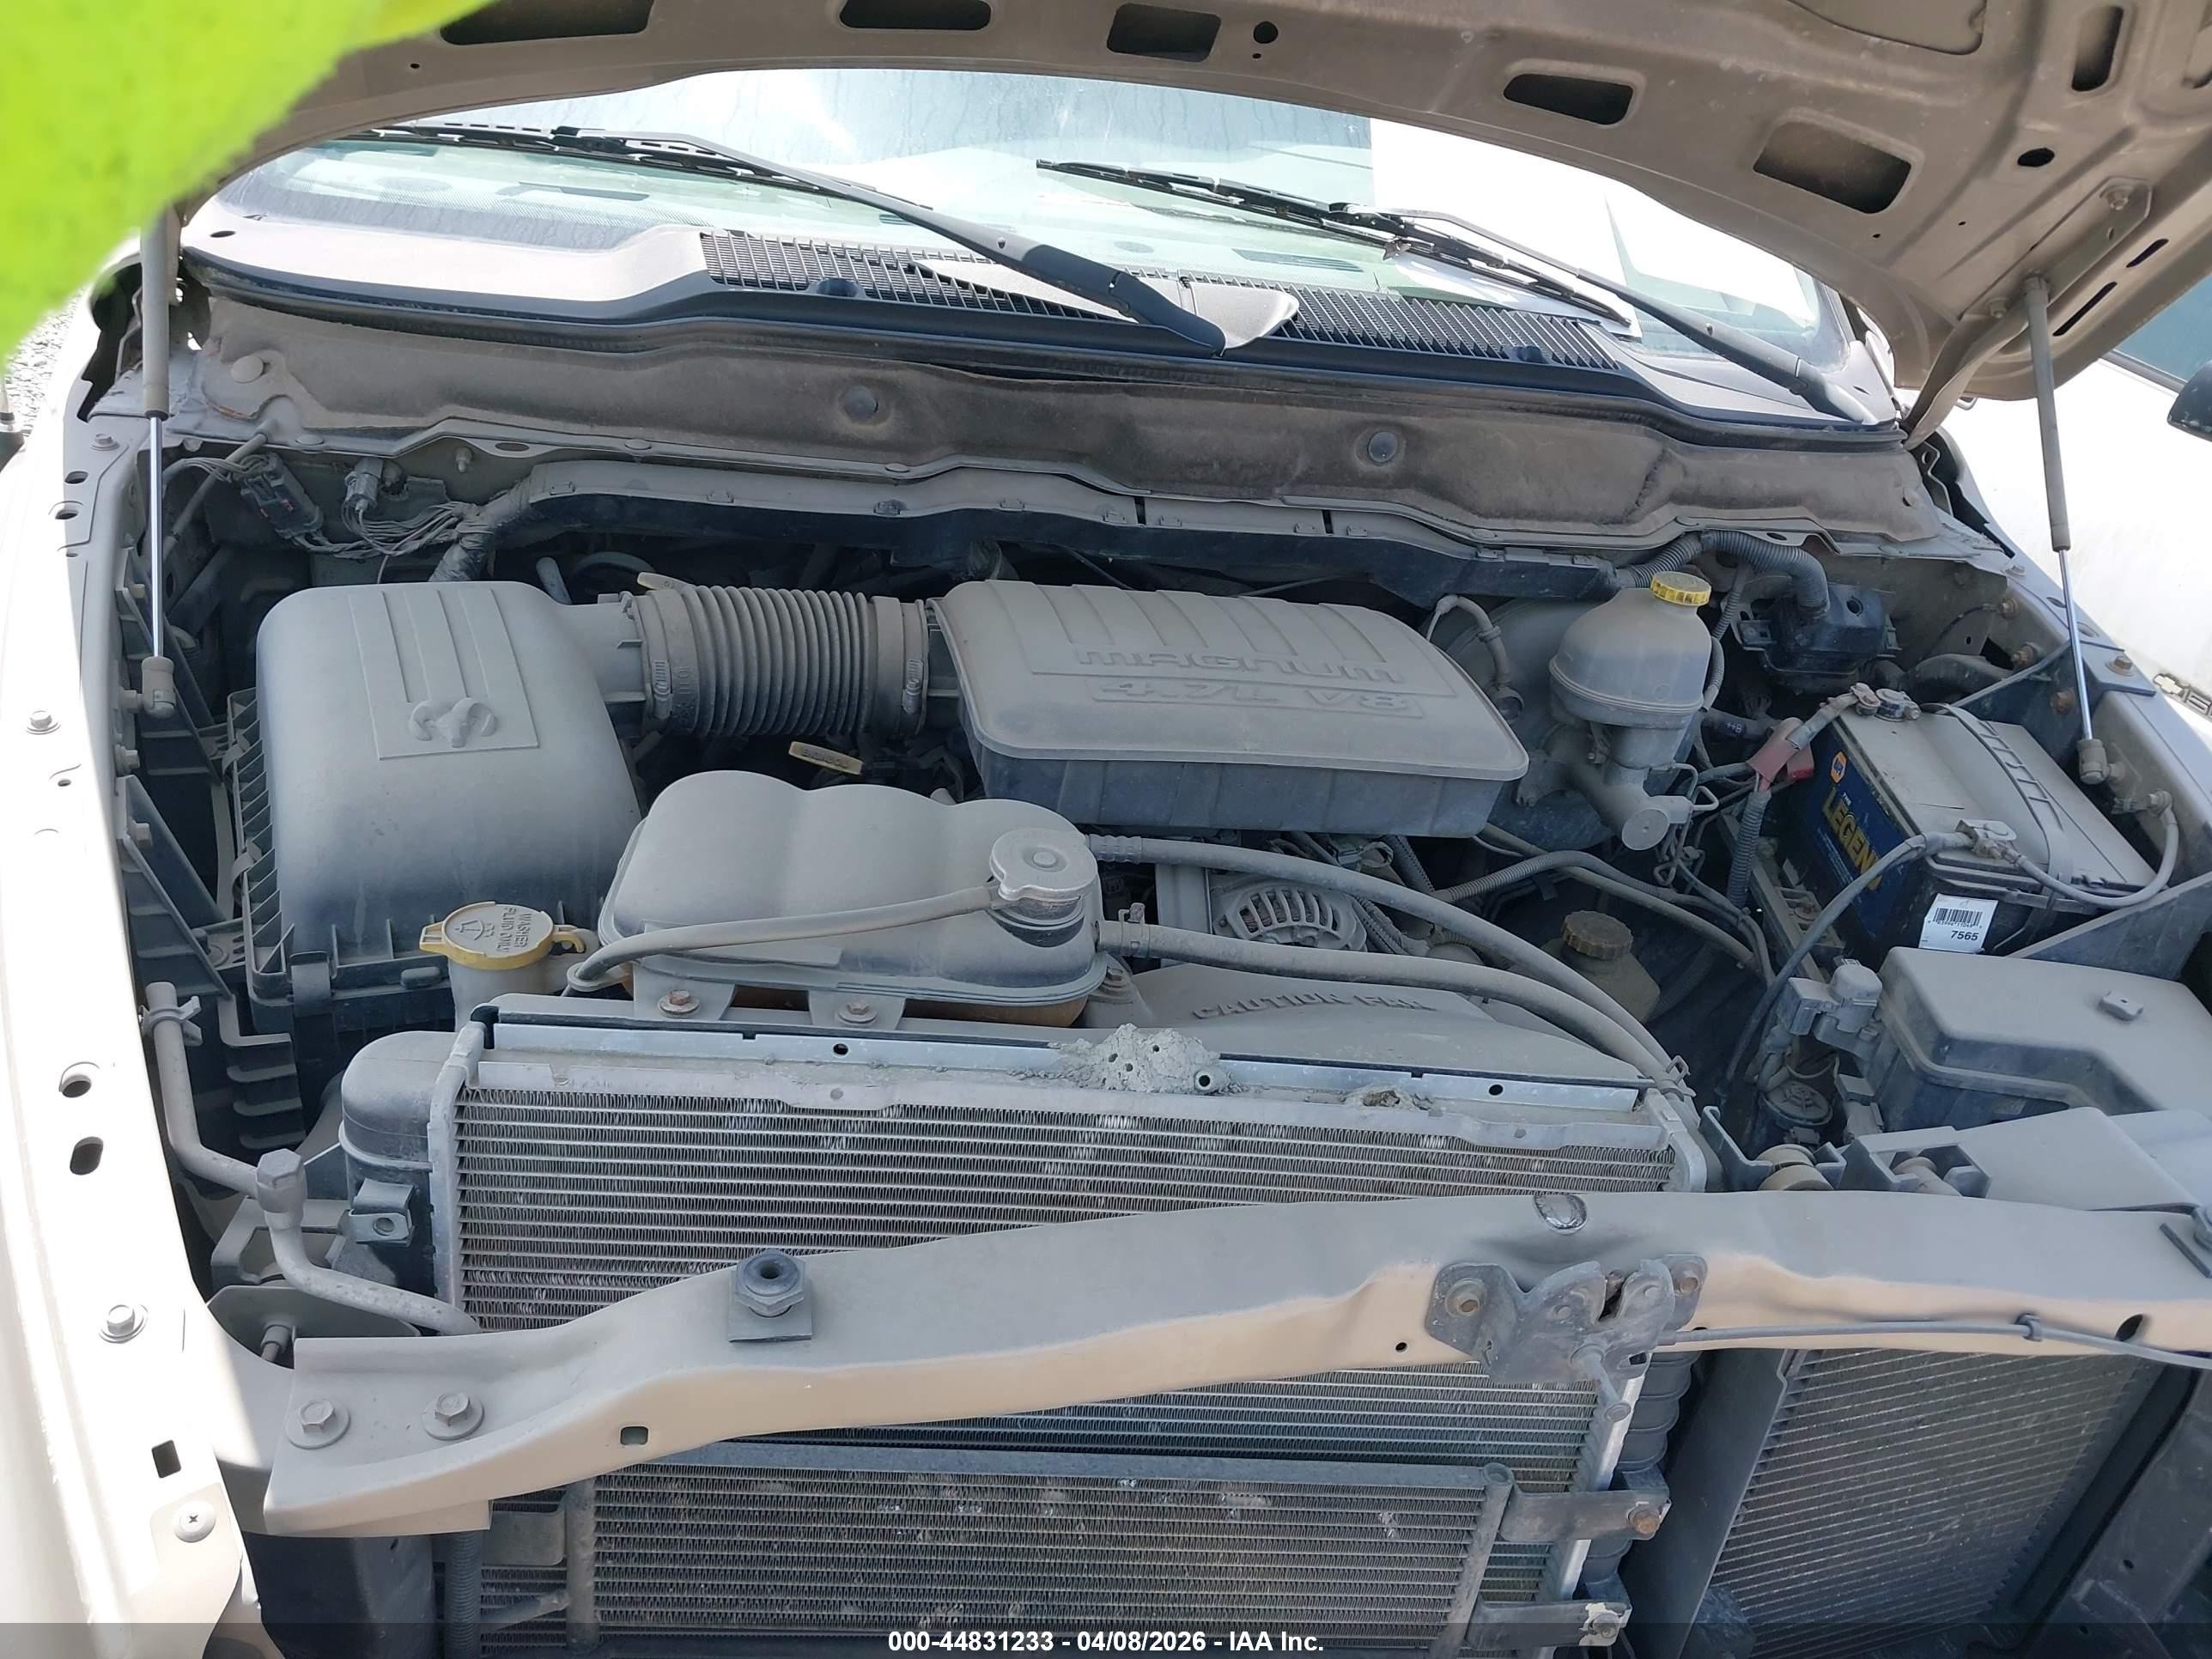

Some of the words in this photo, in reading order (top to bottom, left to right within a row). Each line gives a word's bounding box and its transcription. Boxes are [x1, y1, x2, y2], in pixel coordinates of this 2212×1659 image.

[1100, 683, 1279, 702] 4.7L
[1304, 689, 1410, 711] V8
[501, 907, 517, 931] FLUID
[515, 913, 532, 948] WASHER
[496, 933, 513, 952] ONLY
[1950, 930, 1979, 941] 7565
